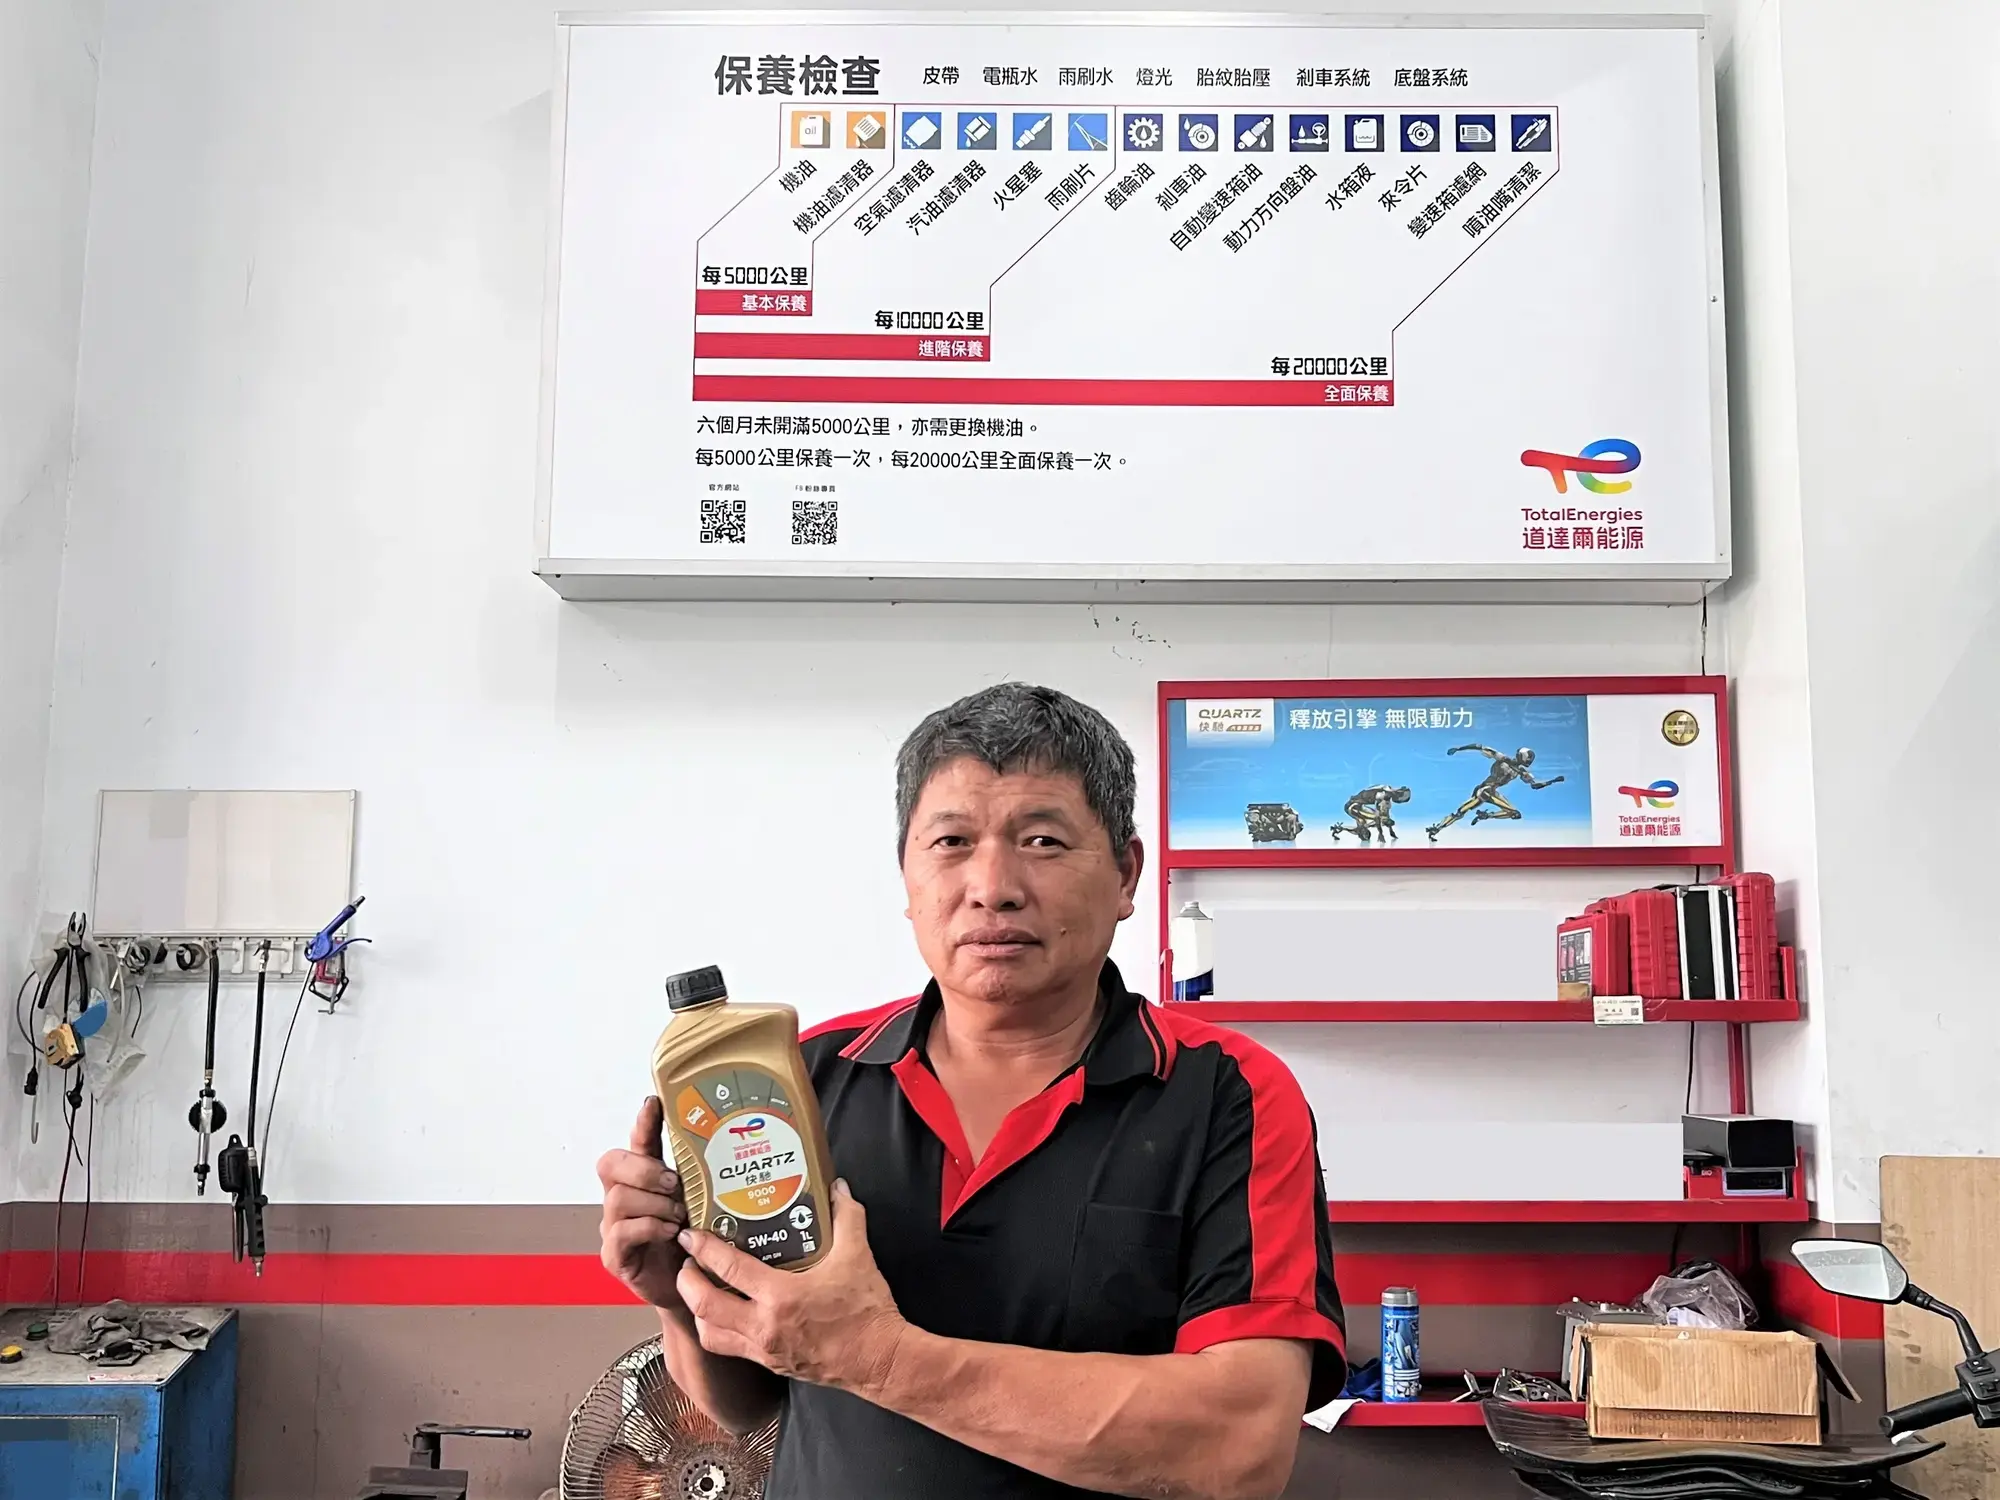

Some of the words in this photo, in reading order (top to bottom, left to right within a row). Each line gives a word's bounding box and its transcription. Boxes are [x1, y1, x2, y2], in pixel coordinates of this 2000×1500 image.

[714, 53, 882, 97] 保養檢查
[922, 66, 960, 86] 皮帶
[982, 66, 1039, 86] 電瓶水
[1058, 66, 1114, 87] 雨刷水
[1136, 66, 1173, 87] 燈光
[1196, 67, 1271, 88] 胎紋胎壓
[1296, 67, 1371, 88] 剎車系統
[1394, 67, 1469, 88] 底盤系統
[778, 159, 818, 194] 機油
[992, 160, 1045, 211] 火星塞
[1044, 162, 1097, 211] 雨刷片
[1103, 162, 1156, 212] 齒輪油
[1155, 162, 1207, 212] 剎車油
[1325, 162, 1377, 212] 水箱液
[1378, 164, 1428, 213] 來令片
[792, 158, 875, 235] 機油濾清器
[853, 159, 935, 236] 空氣濾清器
[905, 159, 987, 236] 汽油濾清器
[1169, 162, 1264, 252] 自動變速箱油
[1222, 163, 1318, 254] 動力方向盤油
[1407, 161, 1488, 240] 變速箱濾網
[1462, 161, 1543, 239] 噴油嘴清潔
[701, 265, 809, 286] 每5000公里
[741, 293, 808, 312] 基本保養
[873, 309, 985, 331] 每10000公里
[918, 339, 985, 358] 進階保養
[1270, 355, 1389, 377] 每20000公里
[1324, 384, 1390, 403] 全面保養
[1521, 507, 1643, 524] TotalEnergies
[1522, 526, 1644, 550] 道達爾能源
[1199, 708, 1262, 719] QUARTZ
[1289, 708, 1379, 730] 釋放引擎
[1385, 707, 1474, 729] 無限動力
[719, 1151, 796, 1180] QUARTZ
[747, 1185, 776, 1200] 9000
[757, 1197, 771, 1207] SN
[747, 1229, 788, 1249] 5W-40
[800, 1230, 813, 1241] 1L
